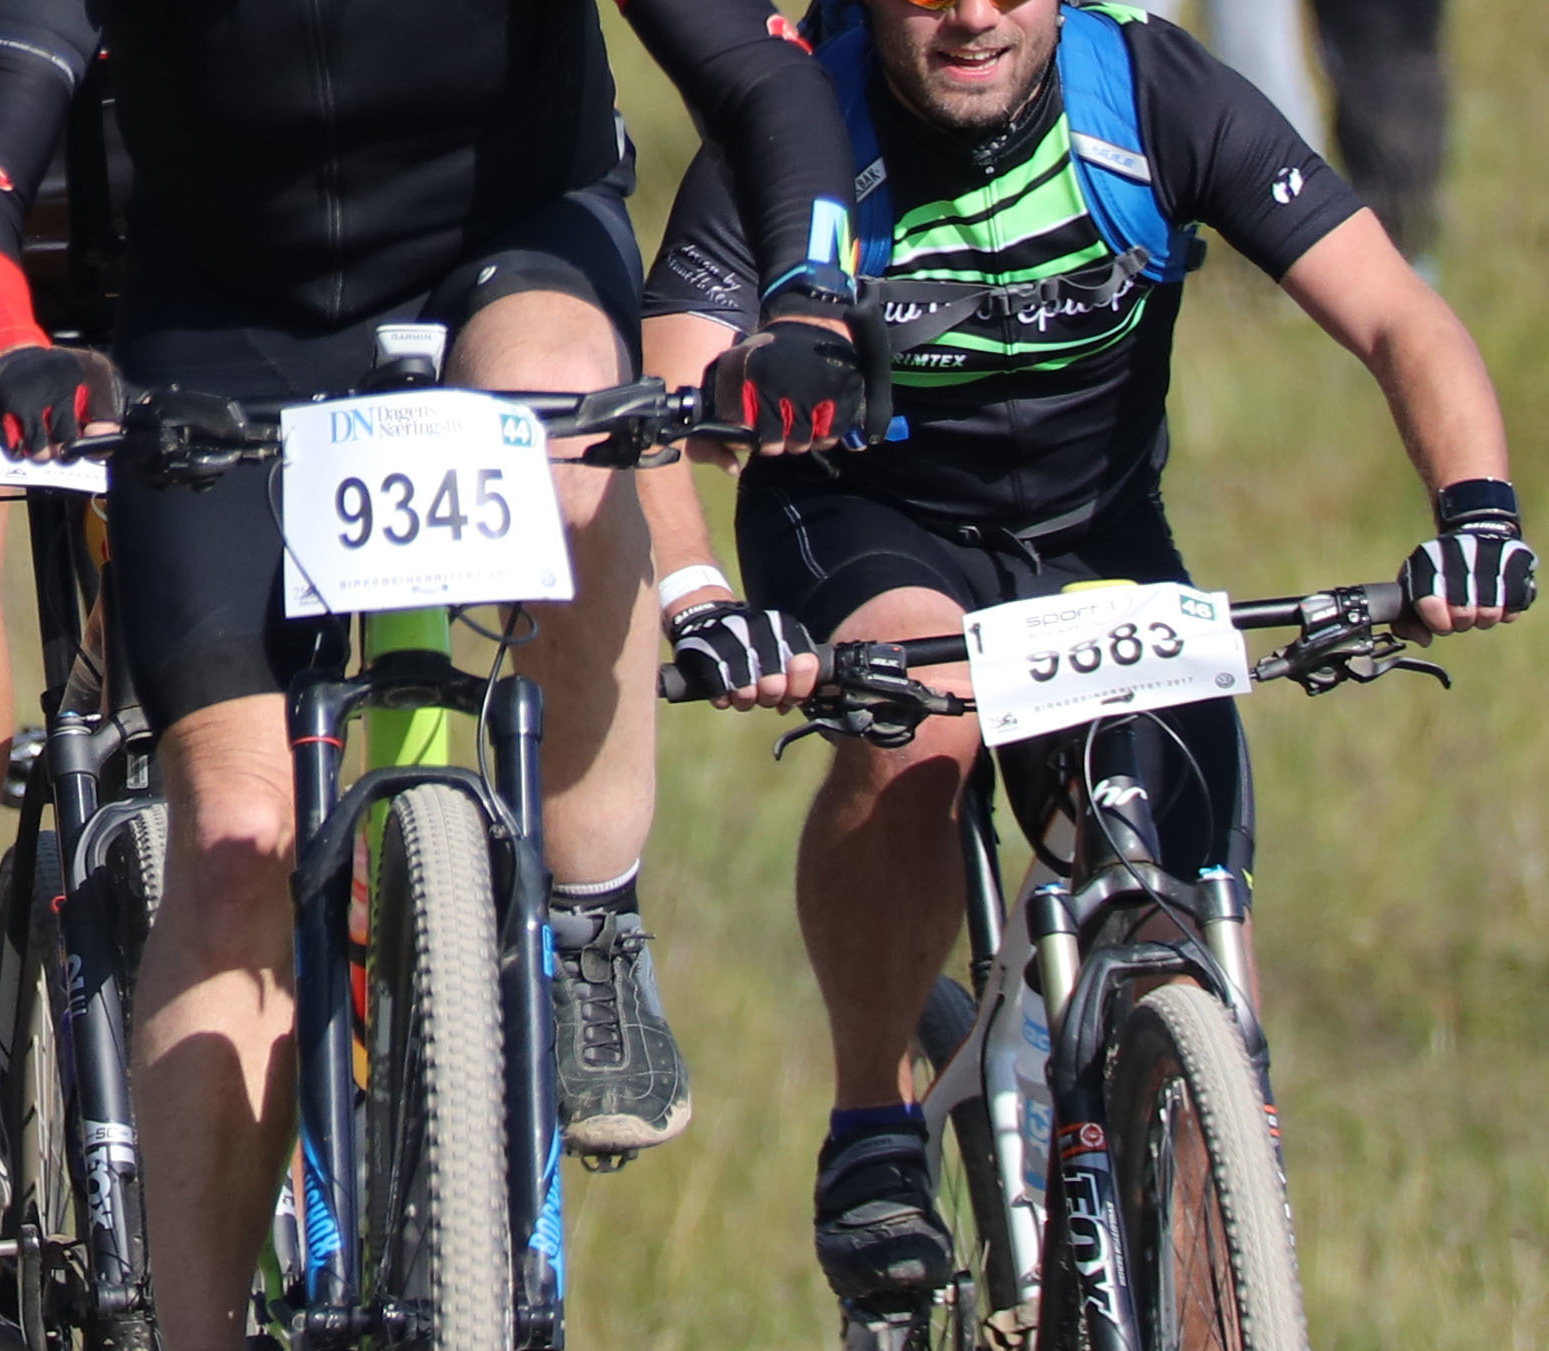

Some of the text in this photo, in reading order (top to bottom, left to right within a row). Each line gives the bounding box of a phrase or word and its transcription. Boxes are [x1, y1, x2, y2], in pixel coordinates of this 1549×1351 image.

[722, 271, 742, 292] by
[391, 333, 432, 342] GARMIN
[892, 353, 966, 368] RIMTEX
[330, 407, 375, 445] DN
[503, 416, 530, 445] 44
[335, 468, 511, 551] 9345
[1181, 599, 1213, 620] 46
[1063, 1168, 1122, 1325] FOX
